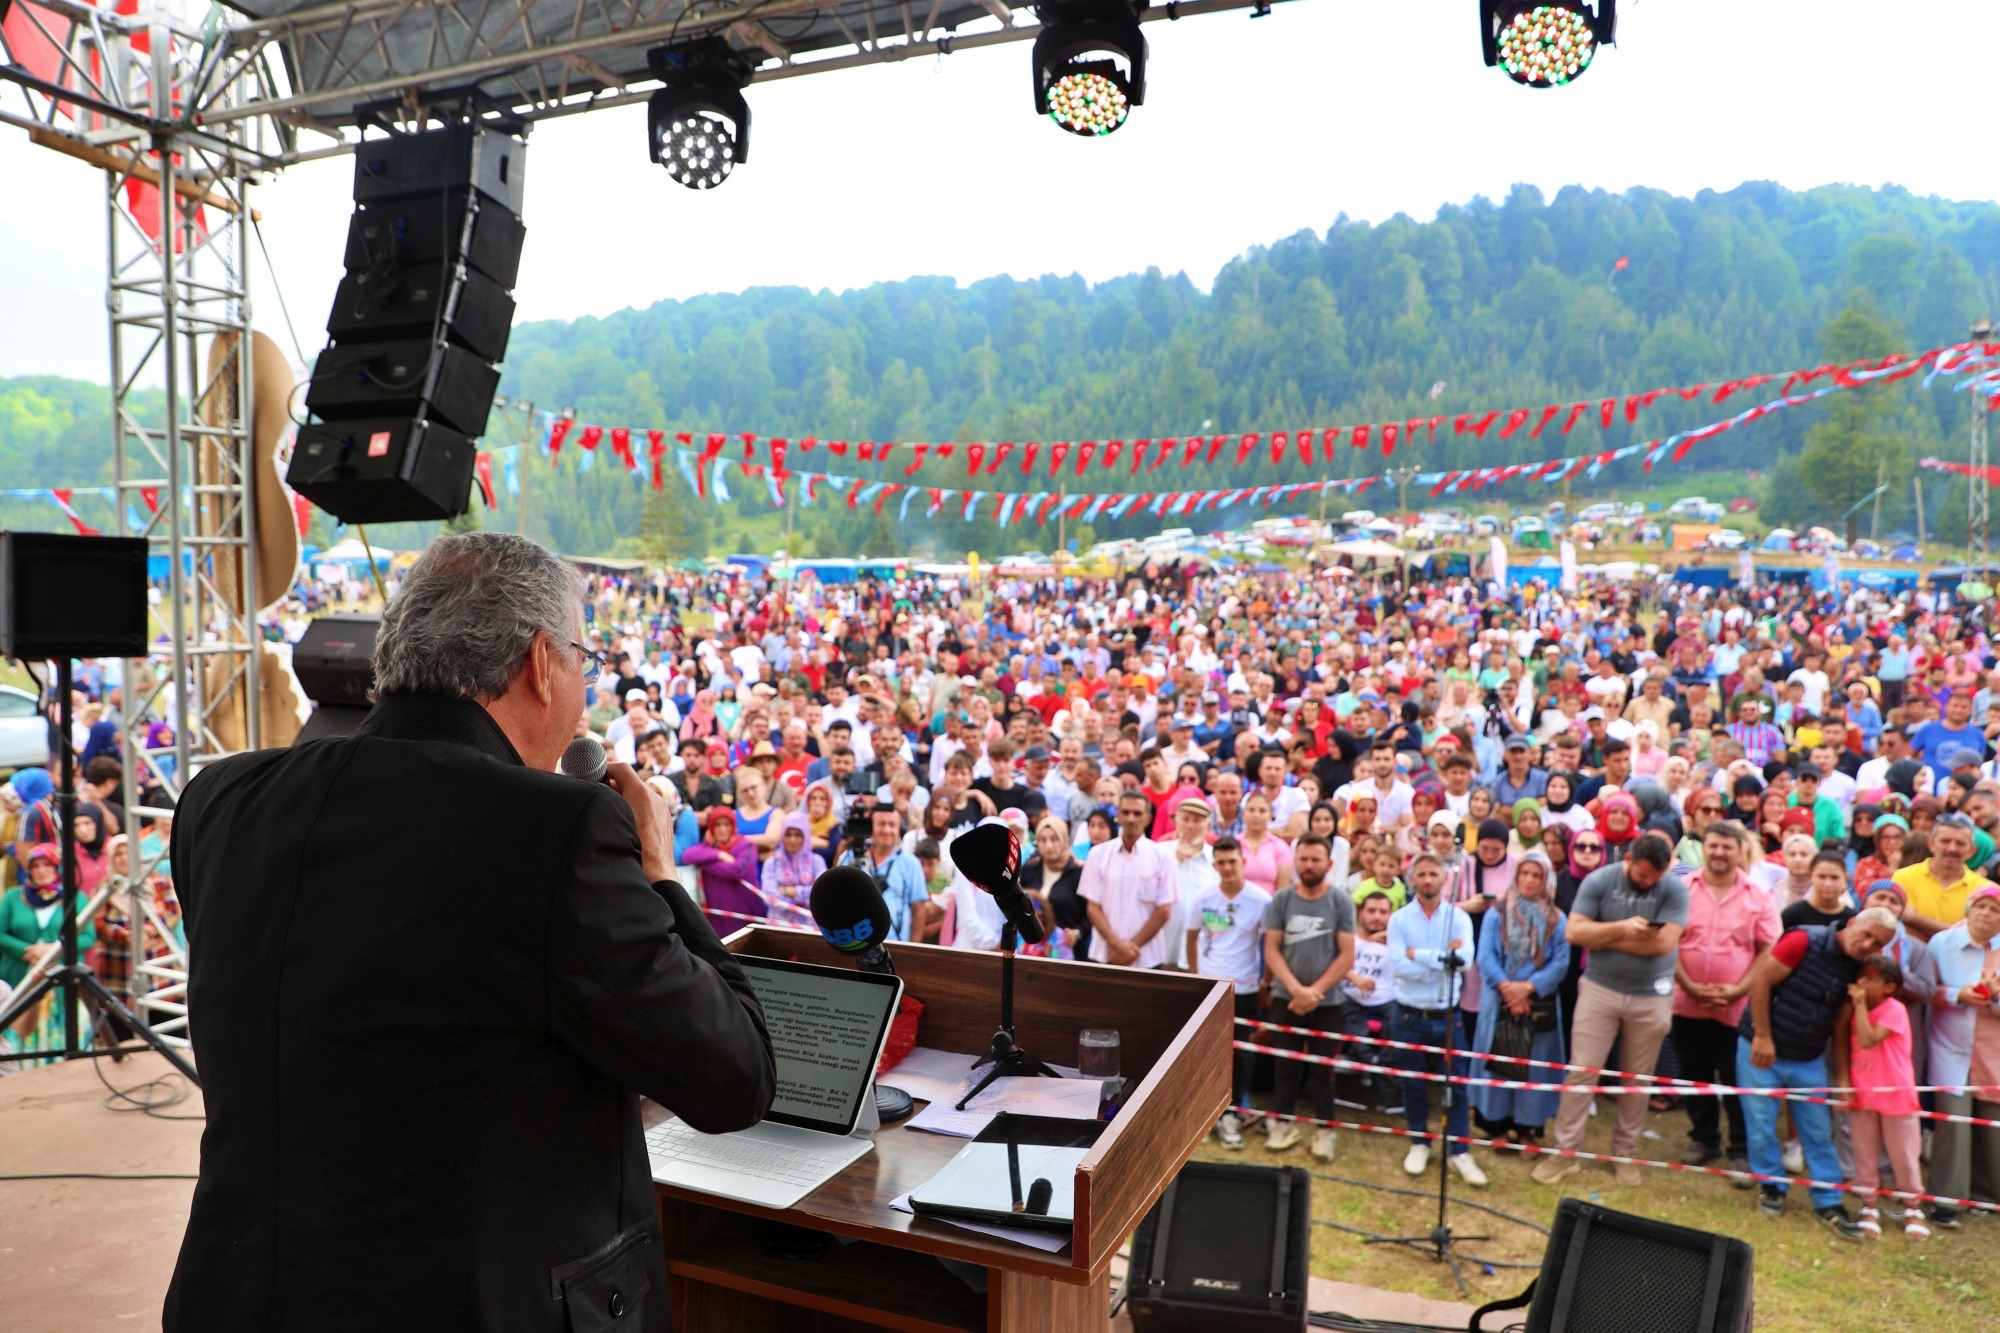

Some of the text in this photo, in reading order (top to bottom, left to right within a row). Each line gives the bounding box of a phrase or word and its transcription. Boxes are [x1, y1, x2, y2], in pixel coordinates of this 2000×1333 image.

[765, 987, 788, 996] sevgiyle
[806, 1004, 831, 1013] geldiniz.
[846, 1016, 870, 1024] dilerim.
[783, 1023, 809, 1032] teşekkür
[813, 1028, 832, 1036] etmek
[837, 1032, 868, 1042] istiyorum.
[828, 1024, 849, 1032] devam
[849, 1027, 870, 1035] ettiren
[786, 1038, 821, 1048] sunuyorum.
[795, 1032, 819, 1041] Merhum
[821, 1036, 839, 1044] Yaşar
[817, 1053, 840, 1062] Soykan
[841, 1057, 861, 1065] olmak
[820, 1060, 839, 1069] emeği
[840, 1064, 858, 1072] geçen
[809, 1085, 827, 1093] şehir.
[827, 1095, 848, 1105] gelmiş
